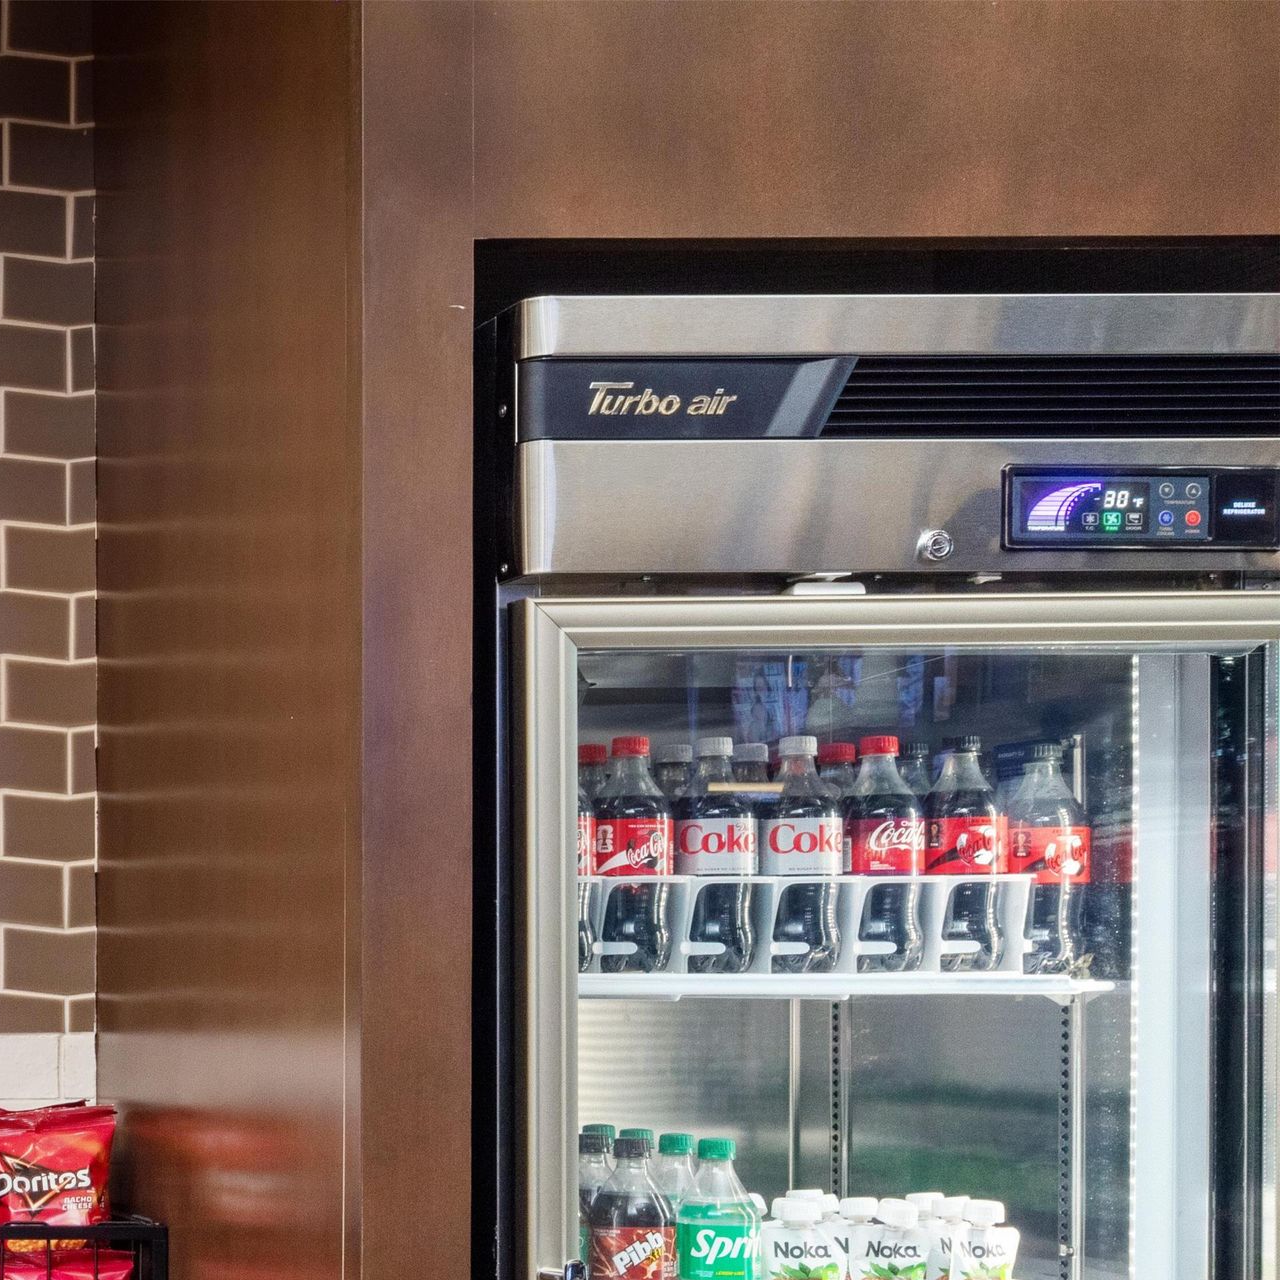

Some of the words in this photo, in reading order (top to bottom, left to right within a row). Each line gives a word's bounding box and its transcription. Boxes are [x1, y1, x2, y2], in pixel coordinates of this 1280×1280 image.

[588, 381, 681, 415] Turbo
[687, 388, 737, 415] air
[680, 823, 756, 855] Coke
[768, 823, 843, 854] Coke
[64, 1195, 93, 1203] NACHO
[613, 1231, 665, 1276] Pibb
[773, 1240, 832, 1259] Noka
[865, 1240, 921, 1259] Noka
[960, 1240, 1006, 1259] Noka
